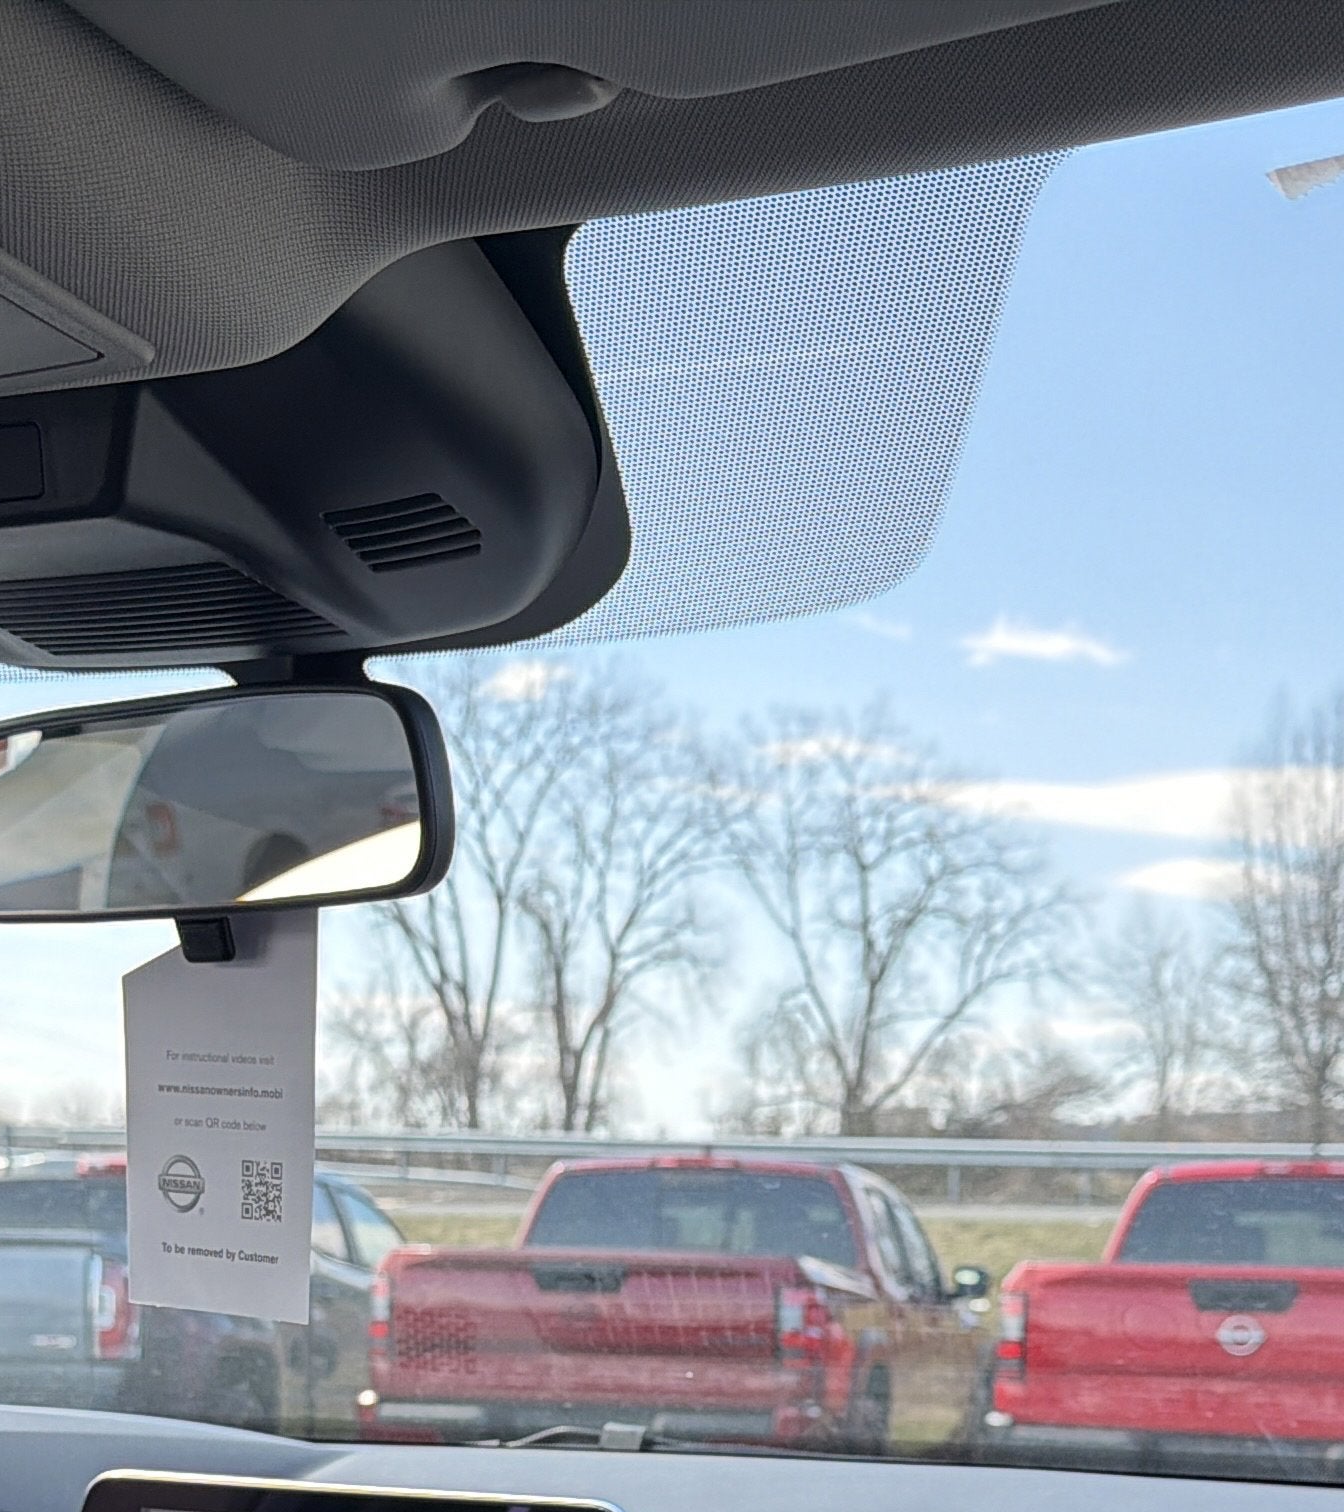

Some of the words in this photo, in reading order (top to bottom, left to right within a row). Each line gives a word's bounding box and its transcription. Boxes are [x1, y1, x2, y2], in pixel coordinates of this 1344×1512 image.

[166, 1050, 180, 1061] For
[181, 1051, 230, 1063] instructional
[231, 1054, 257, 1065] videos
[259, 1055, 275, 1066] visit
[158, 1084, 283, 1099] www.nissanownersinfo.mobi
[174, 1117, 183, 1126] or
[184, 1118, 204, 1128] scan
[205, 1117, 220, 1129] QR
[221, 1119, 242, 1130] code
[243, 1120, 267, 1131] below
[161, 1177, 202, 1191] NISSAN
[161, 1241, 172, 1254] To
[174, 1243, 185, 1255] be
[187, 1247, 224, 1258] removed
[225, 1248, 236, 1262] by
[238, 1250, 279, 1264] Customer
